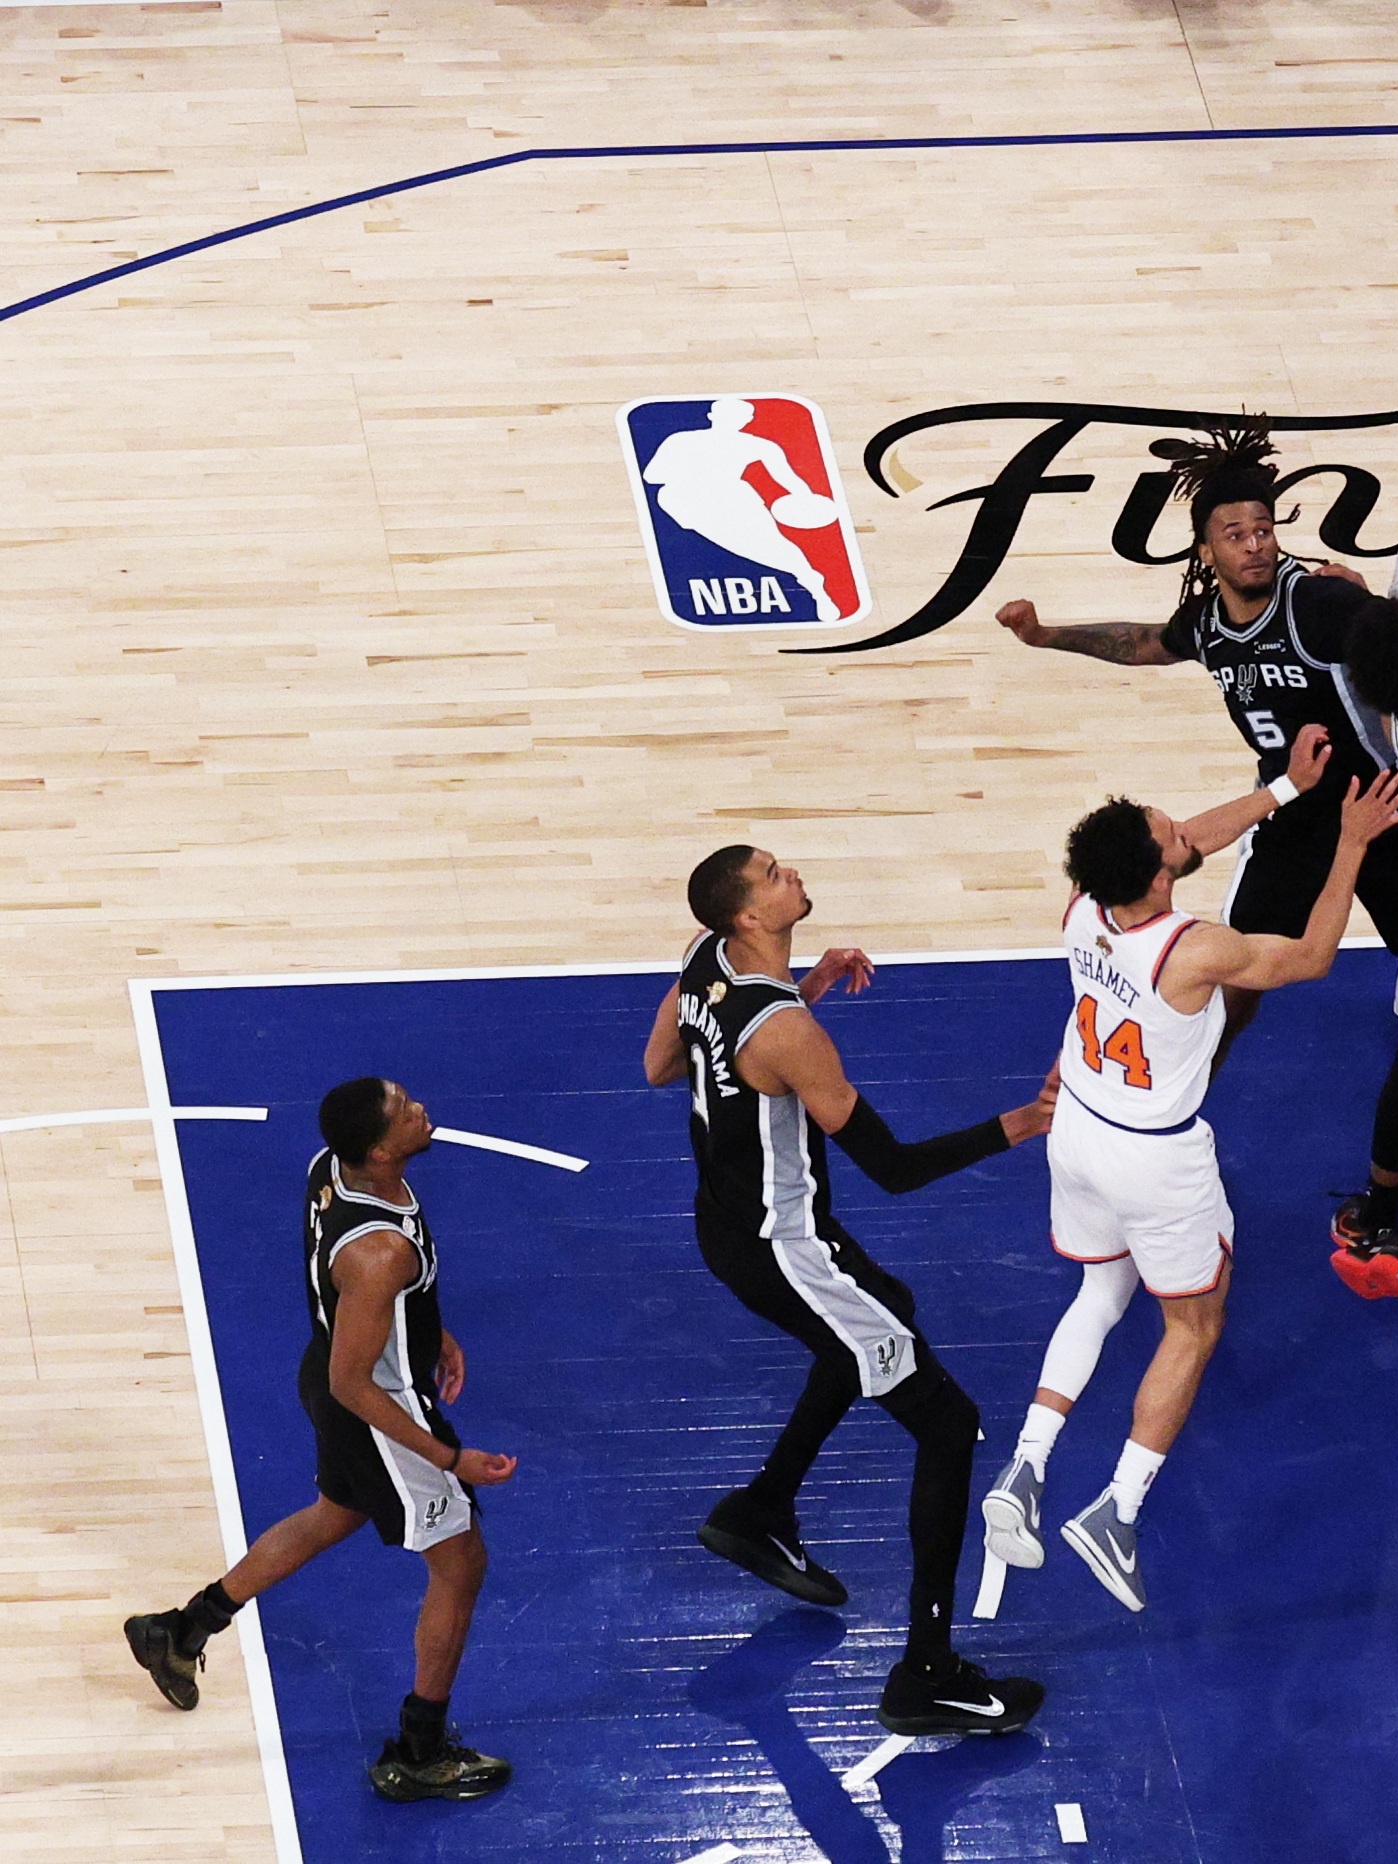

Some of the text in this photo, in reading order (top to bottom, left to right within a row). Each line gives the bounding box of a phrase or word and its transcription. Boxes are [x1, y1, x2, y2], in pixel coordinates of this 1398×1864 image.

[688, 576, 792, 616] NBA
[1245, 710, 1287, 749] 5
[1074, 947, 1141, 1009] SHAMET
